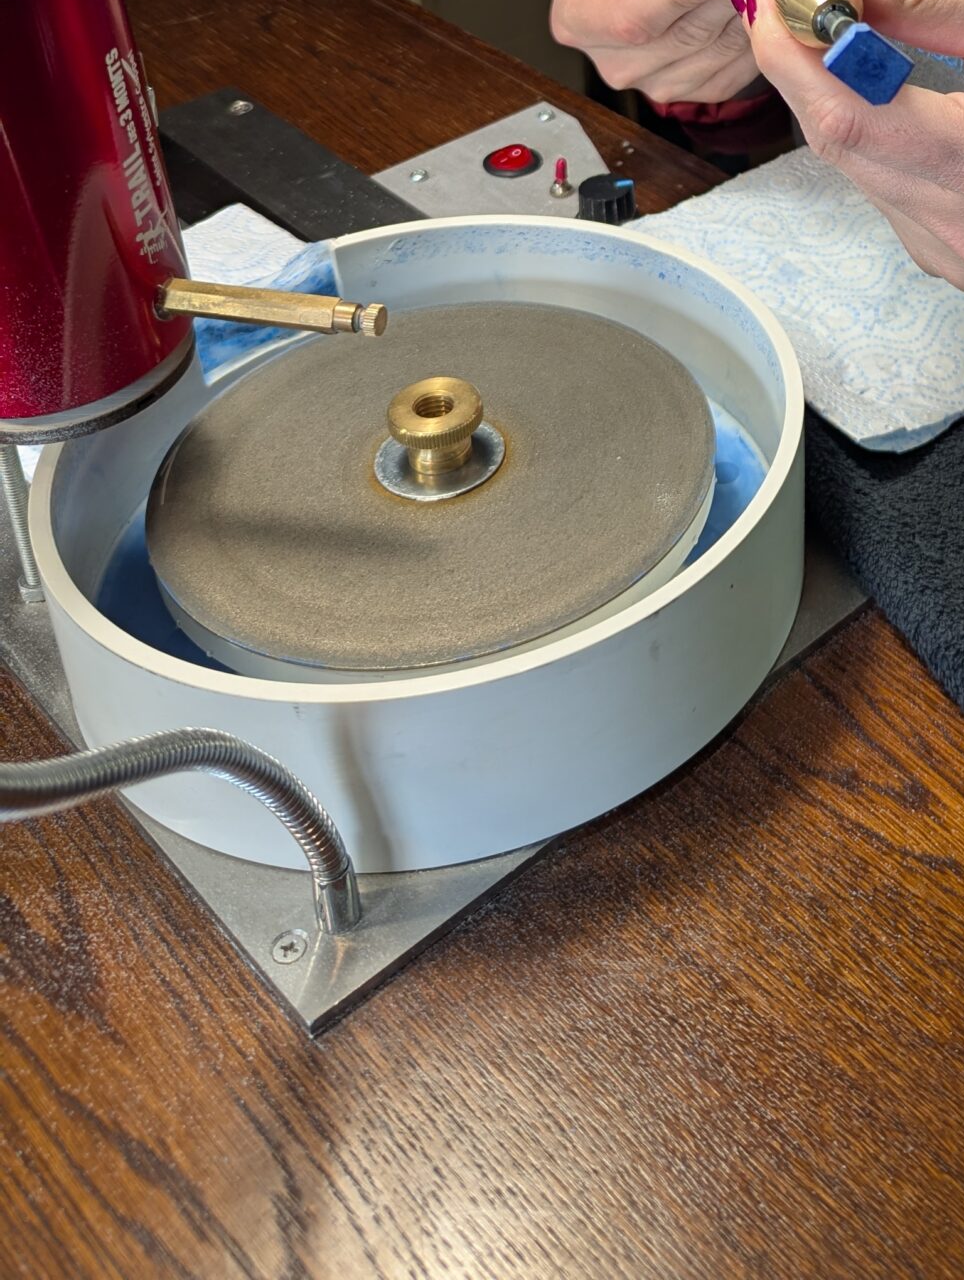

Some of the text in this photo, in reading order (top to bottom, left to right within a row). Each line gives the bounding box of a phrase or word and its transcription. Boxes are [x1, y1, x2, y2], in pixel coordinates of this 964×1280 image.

[105, 47, 130, 113] MONTS
[119, 108, 133, 128] 3
[122, 140, 155, 227] TRAIL
